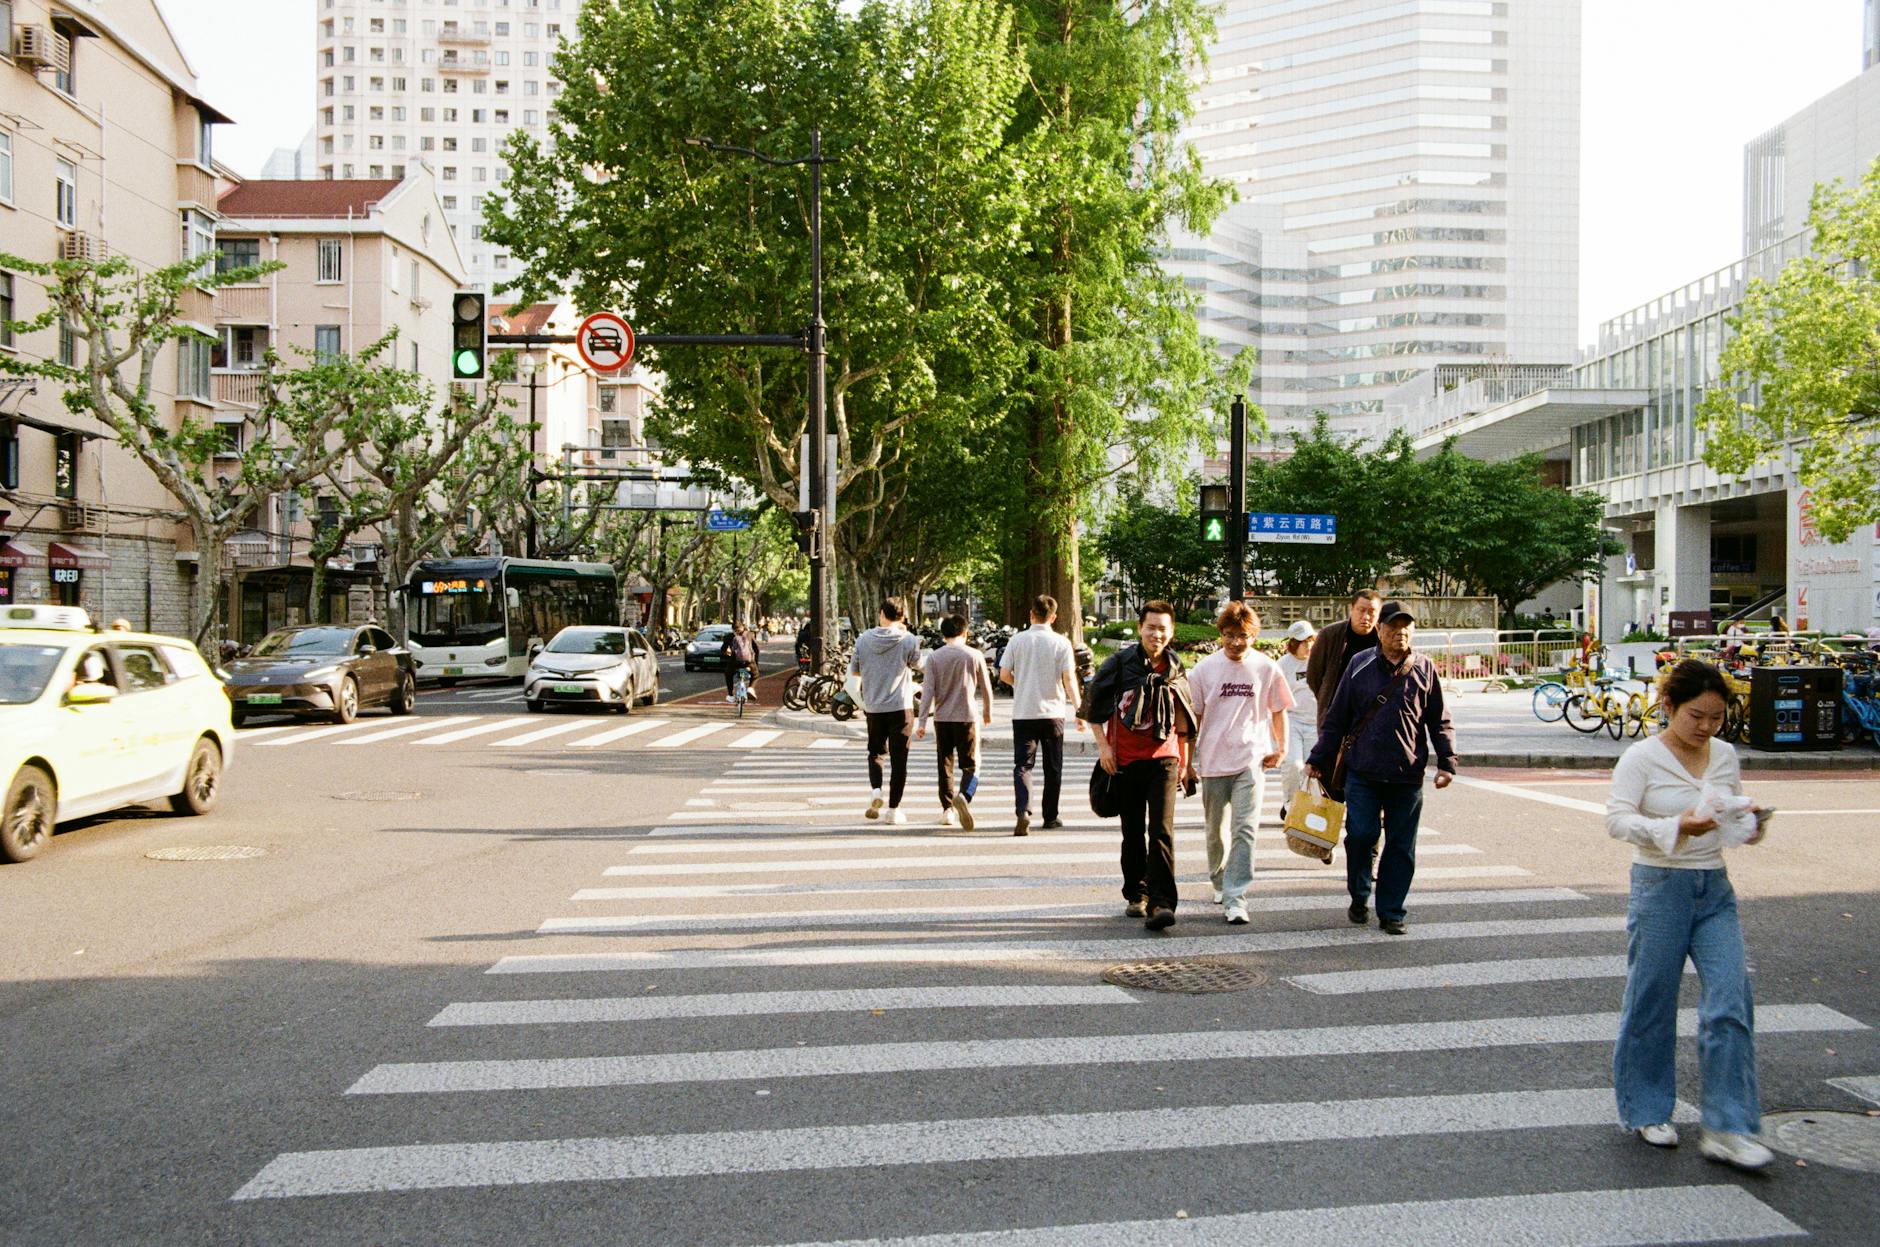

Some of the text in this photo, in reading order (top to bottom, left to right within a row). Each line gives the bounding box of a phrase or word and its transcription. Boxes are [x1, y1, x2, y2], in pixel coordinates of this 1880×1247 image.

[1263, 516, 1322, 530] 紫云西路
[1436, 617, 1483, 628] PLACE
[1221, 682, 1254, 691] Mental
[1219, 689, 1255, 697] Athletic
